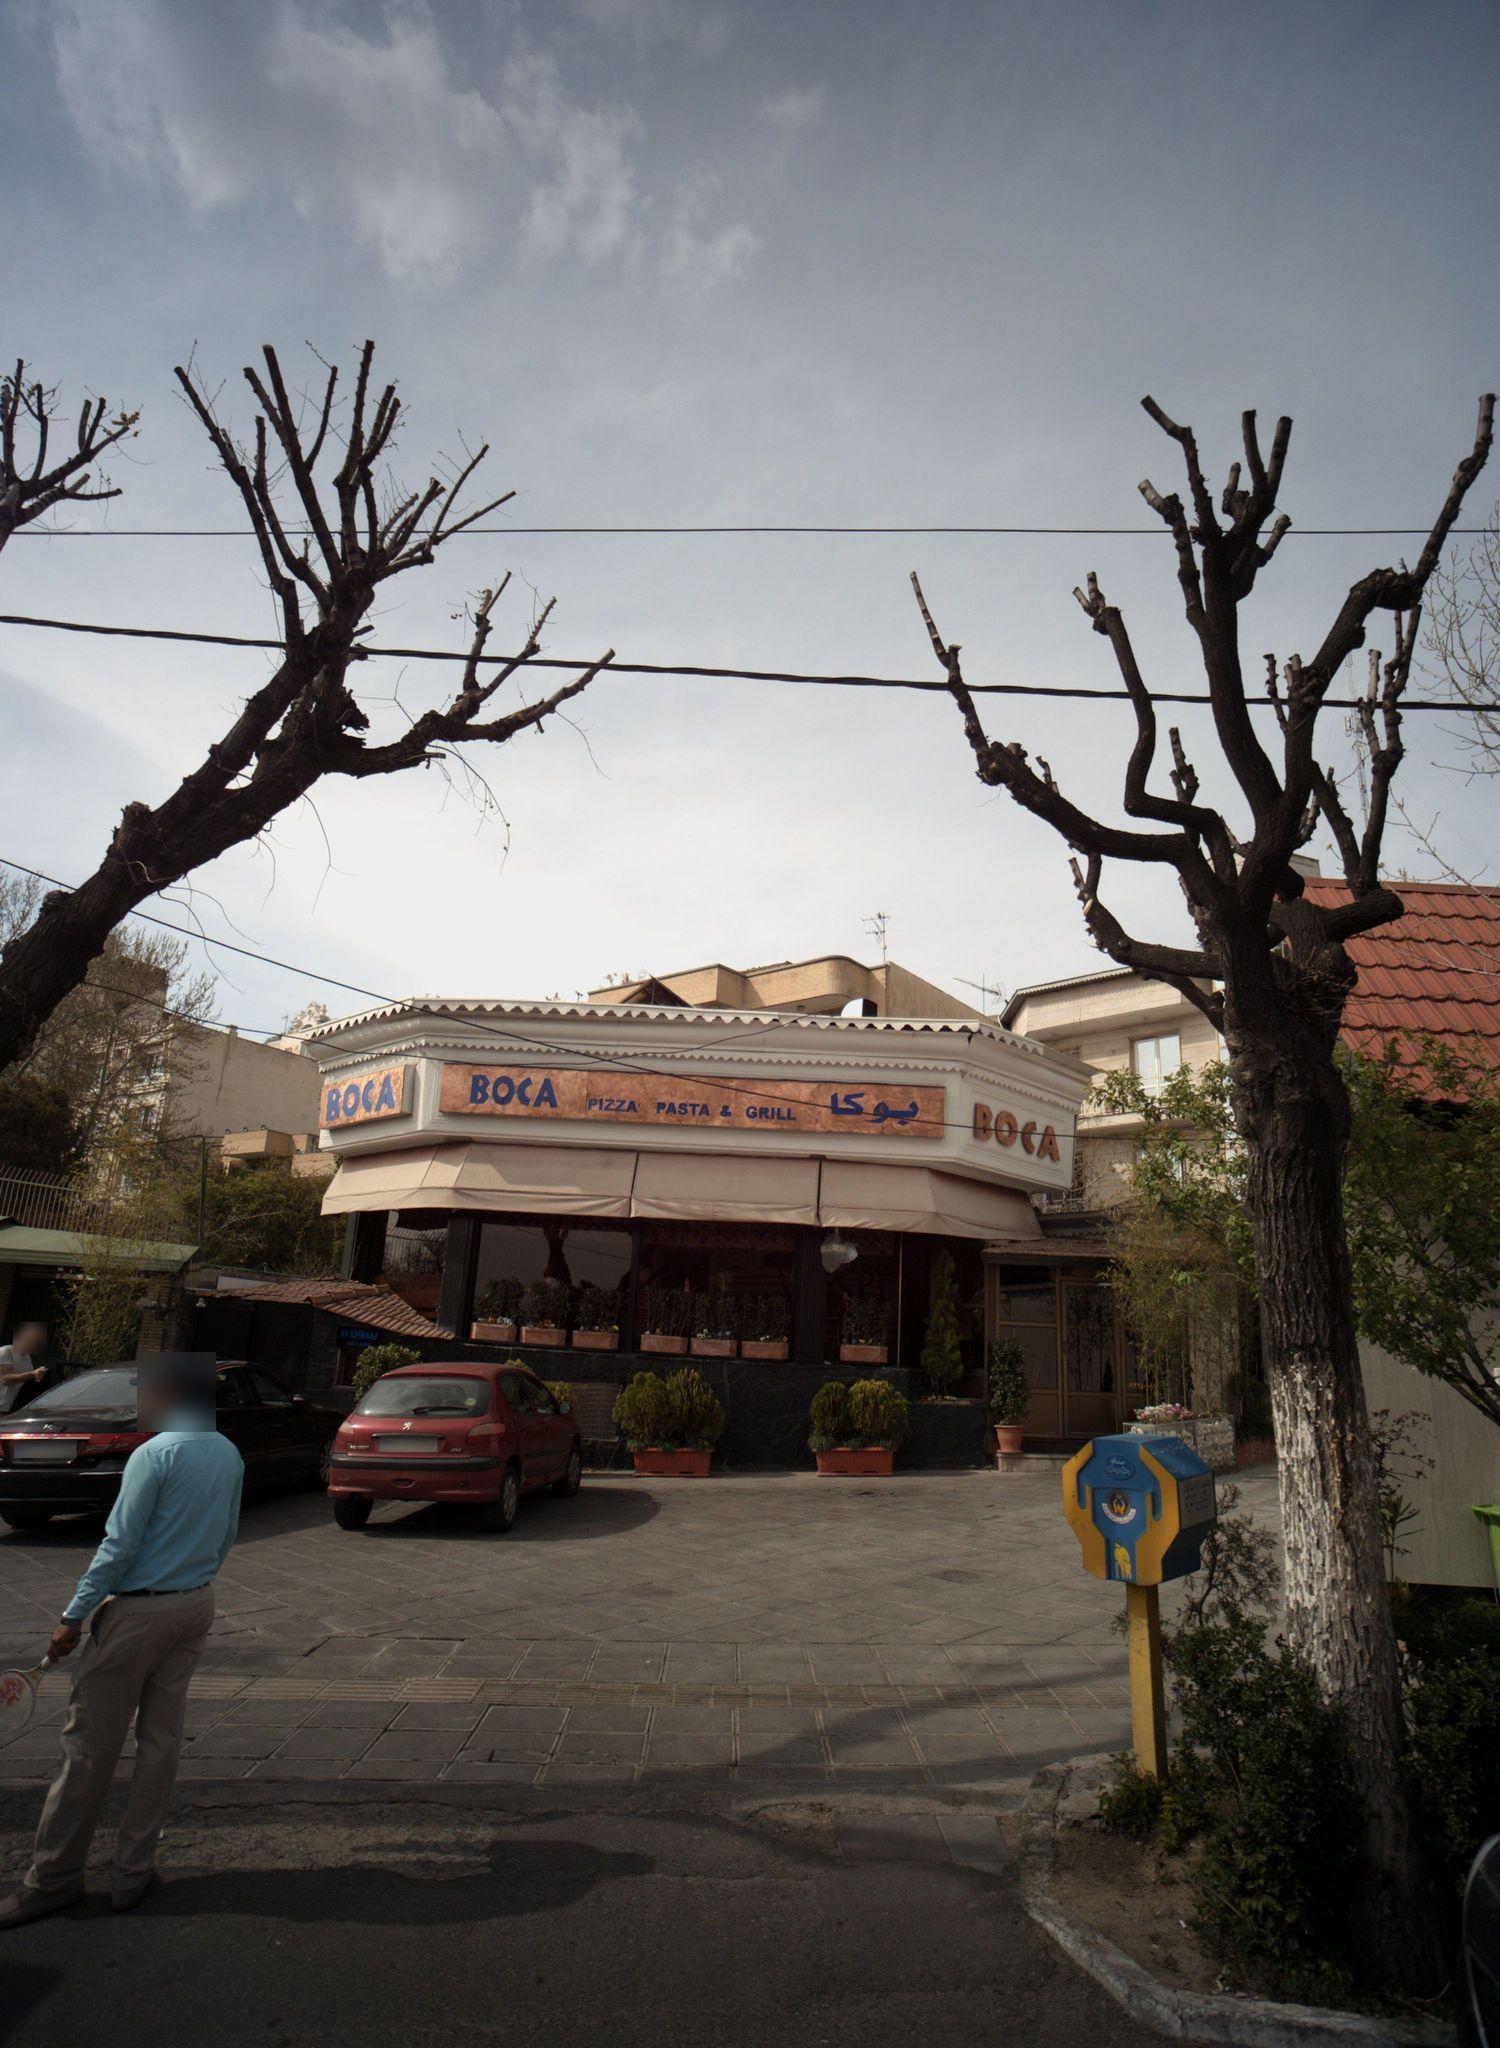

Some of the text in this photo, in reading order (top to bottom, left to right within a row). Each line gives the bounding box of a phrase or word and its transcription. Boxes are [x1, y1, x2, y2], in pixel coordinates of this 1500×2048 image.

[325, 1074, 395, 1122] BOCA
[468, 1074, 558, 1108] BOCA
[587, 1098, 796, 1121] PIZZA PASTA & GRILL
[974, 1103, 1061, 1162] BOCA
